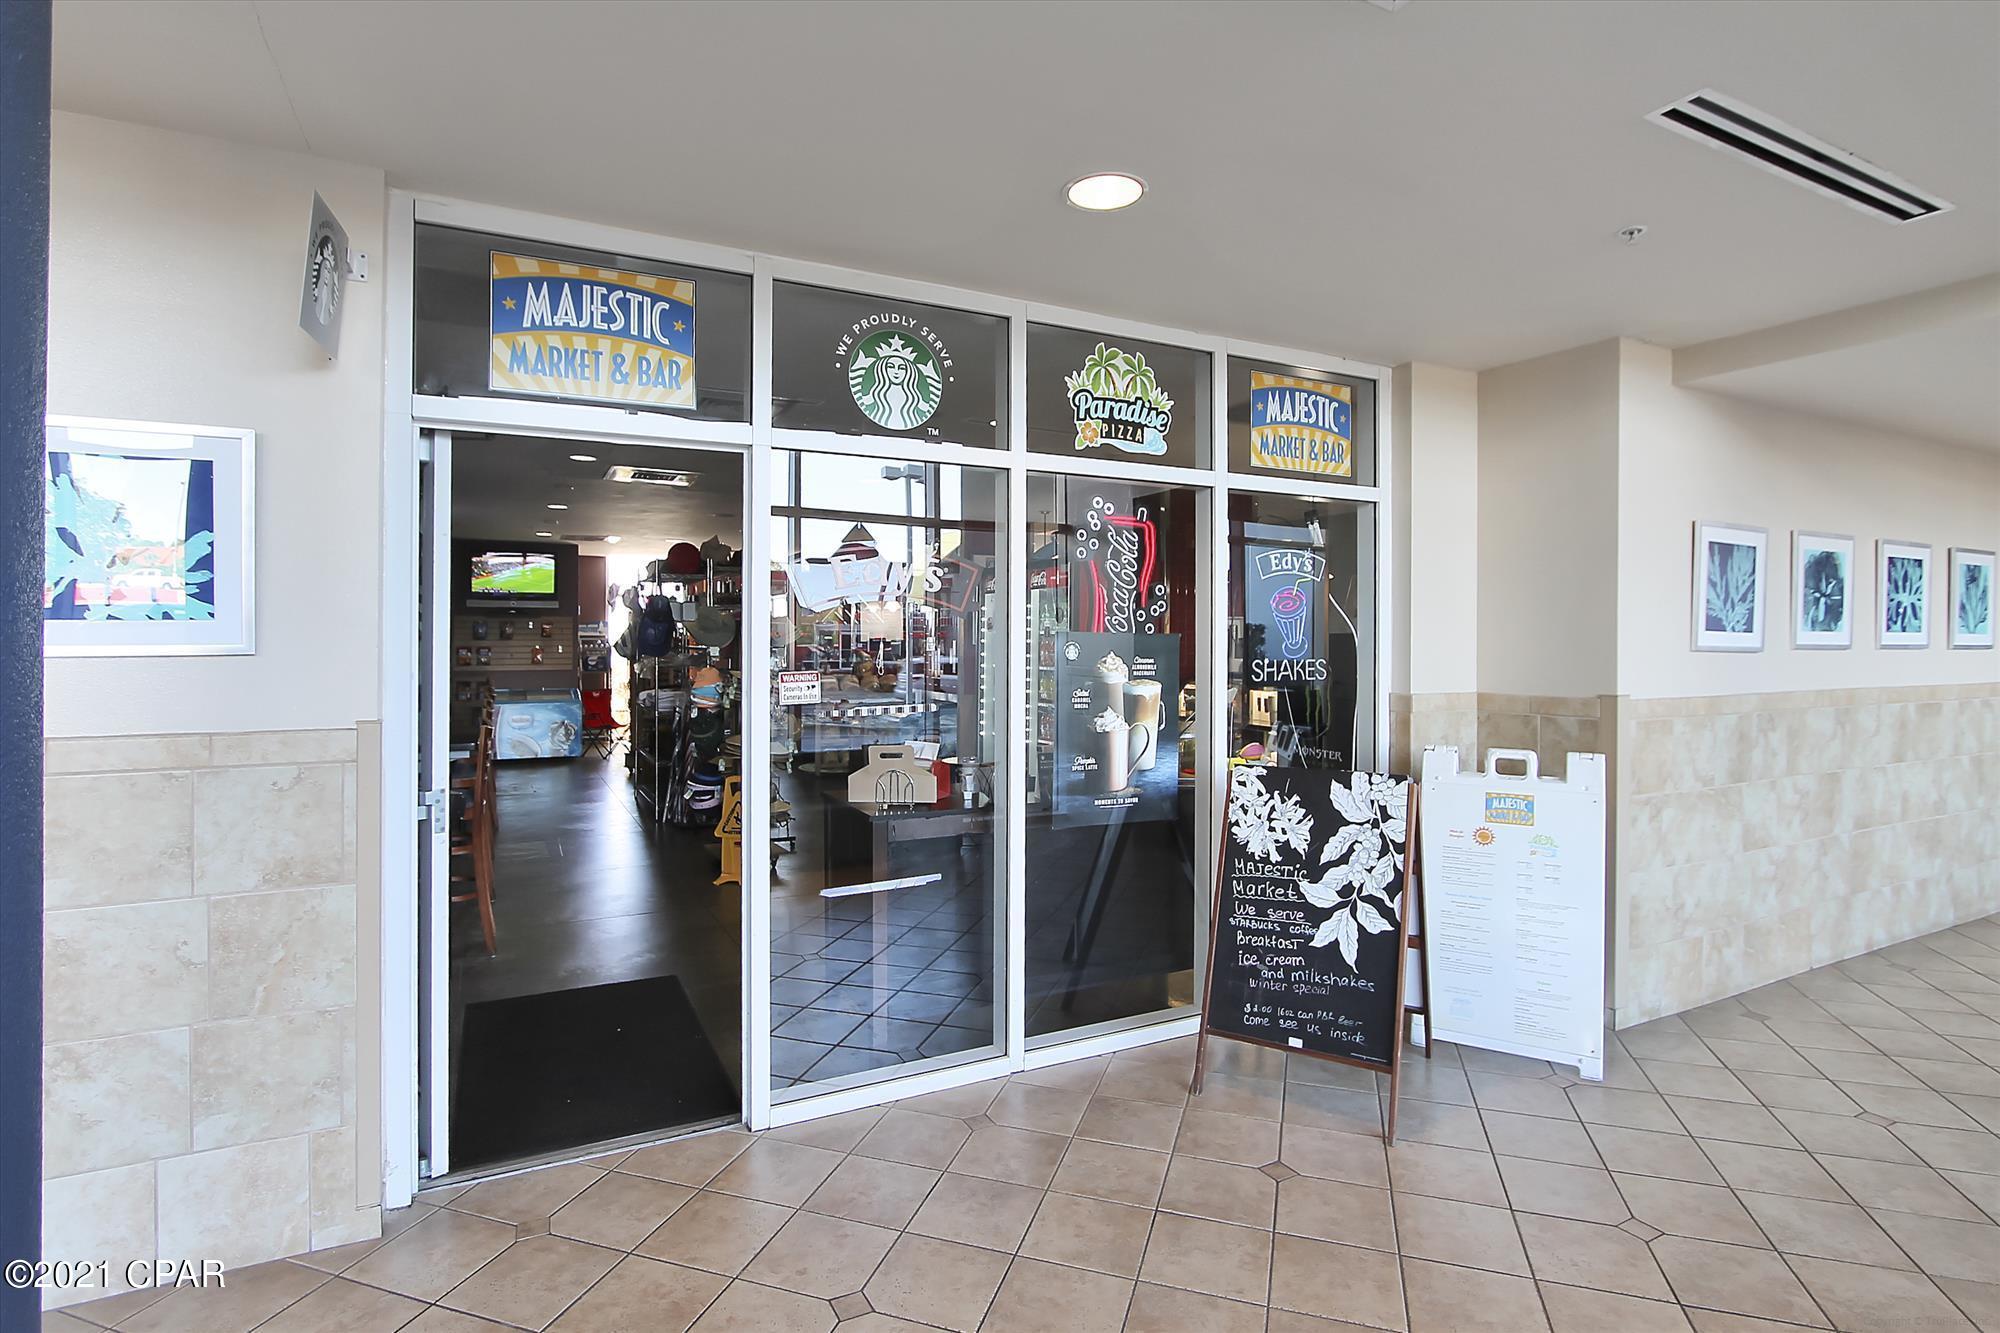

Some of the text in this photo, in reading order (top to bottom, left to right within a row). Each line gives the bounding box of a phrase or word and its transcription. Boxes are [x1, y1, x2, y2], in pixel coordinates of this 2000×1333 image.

[522, 281, 670, 345] MAJESTIC
[836, 313, 953, 368] WE PROUDLY SERVE
[508, 340, 682, 390] MARKET & BAR
[1074, 391, 1168, 430] Paradise
[1266, 390, 1339, 433] MAJESTIC
[1101, 422, 1143, 443] PIZZA
[1260, 431, 1344, 464] MARKET & BAR
[1269, 549, 1314, 573] Edy's
[781, 674, 818, 682] WARNING
[1251, 658, 1328, 682] SHAKES
[1492, 798, 1528, 811] MAJESTIC
[1232, 880, 1298, 899] Market
[1235, 901, 1256, 915] We
[1238, 950, 1306, 966] ice cream
[1261, 968, 1376, 993] and milkshakes
